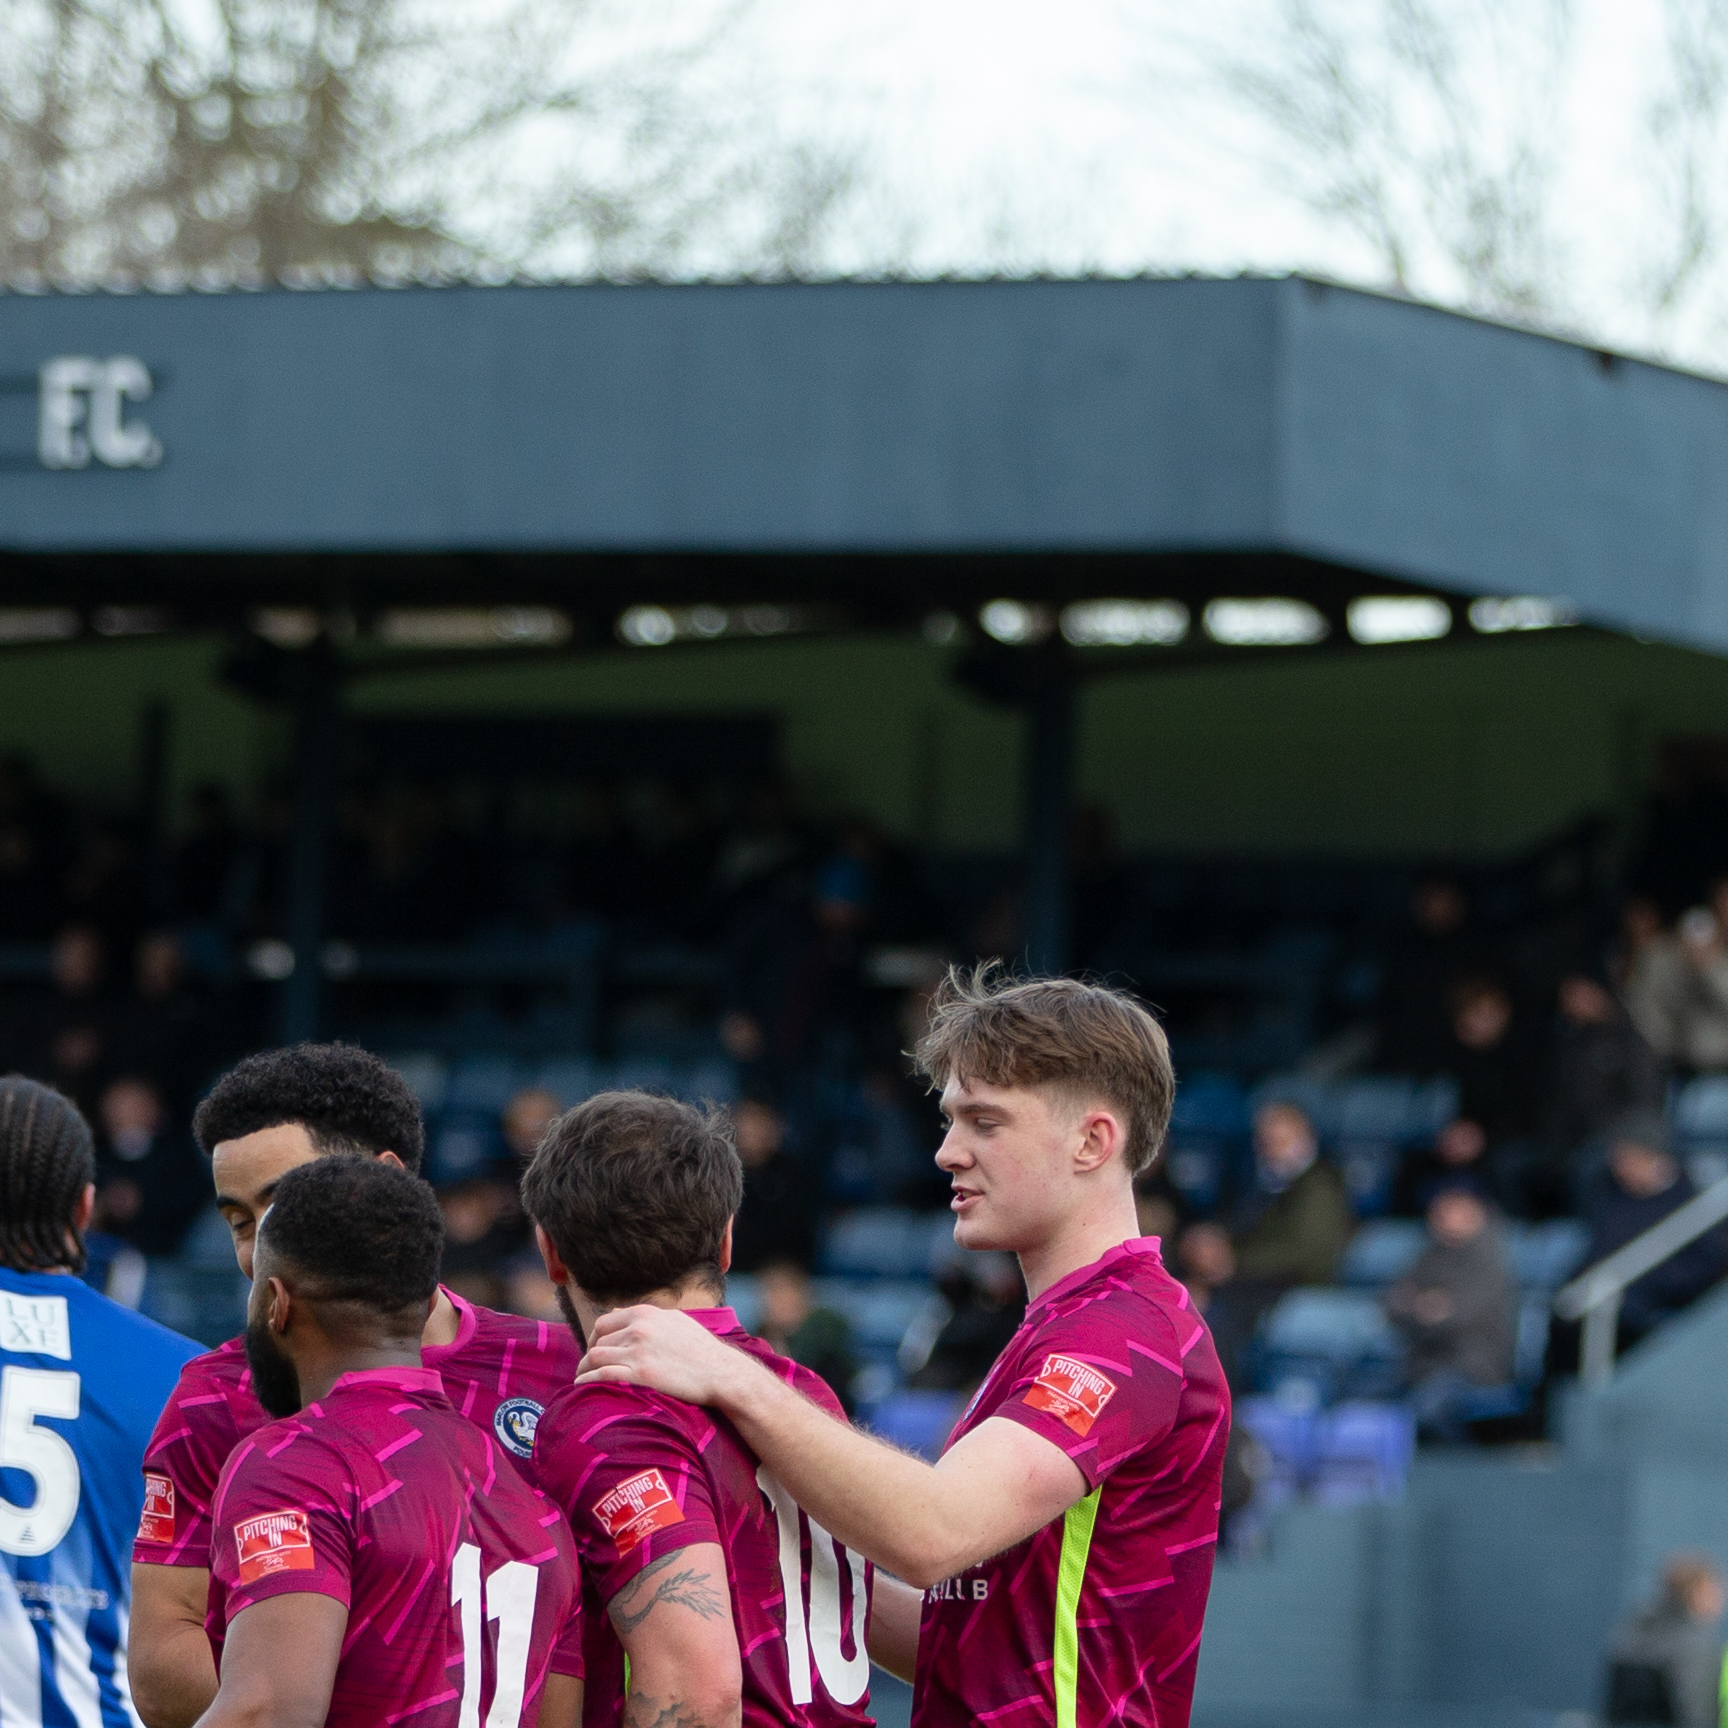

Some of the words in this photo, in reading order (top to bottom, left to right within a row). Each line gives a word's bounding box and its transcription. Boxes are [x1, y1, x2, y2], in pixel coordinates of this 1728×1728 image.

[1051, 1359, 1106, 1396] PITCHING
[1068, 1379, 1085, 1399] IN
[601, 1476, 654, 1518] PITCHING
[627, 1494, 647, 1514] IN
[243, 1514, 298, 1542] PITCHING
[268, 1531, 283, 1548] IN
[756, 1465, 871, 1706] 10
